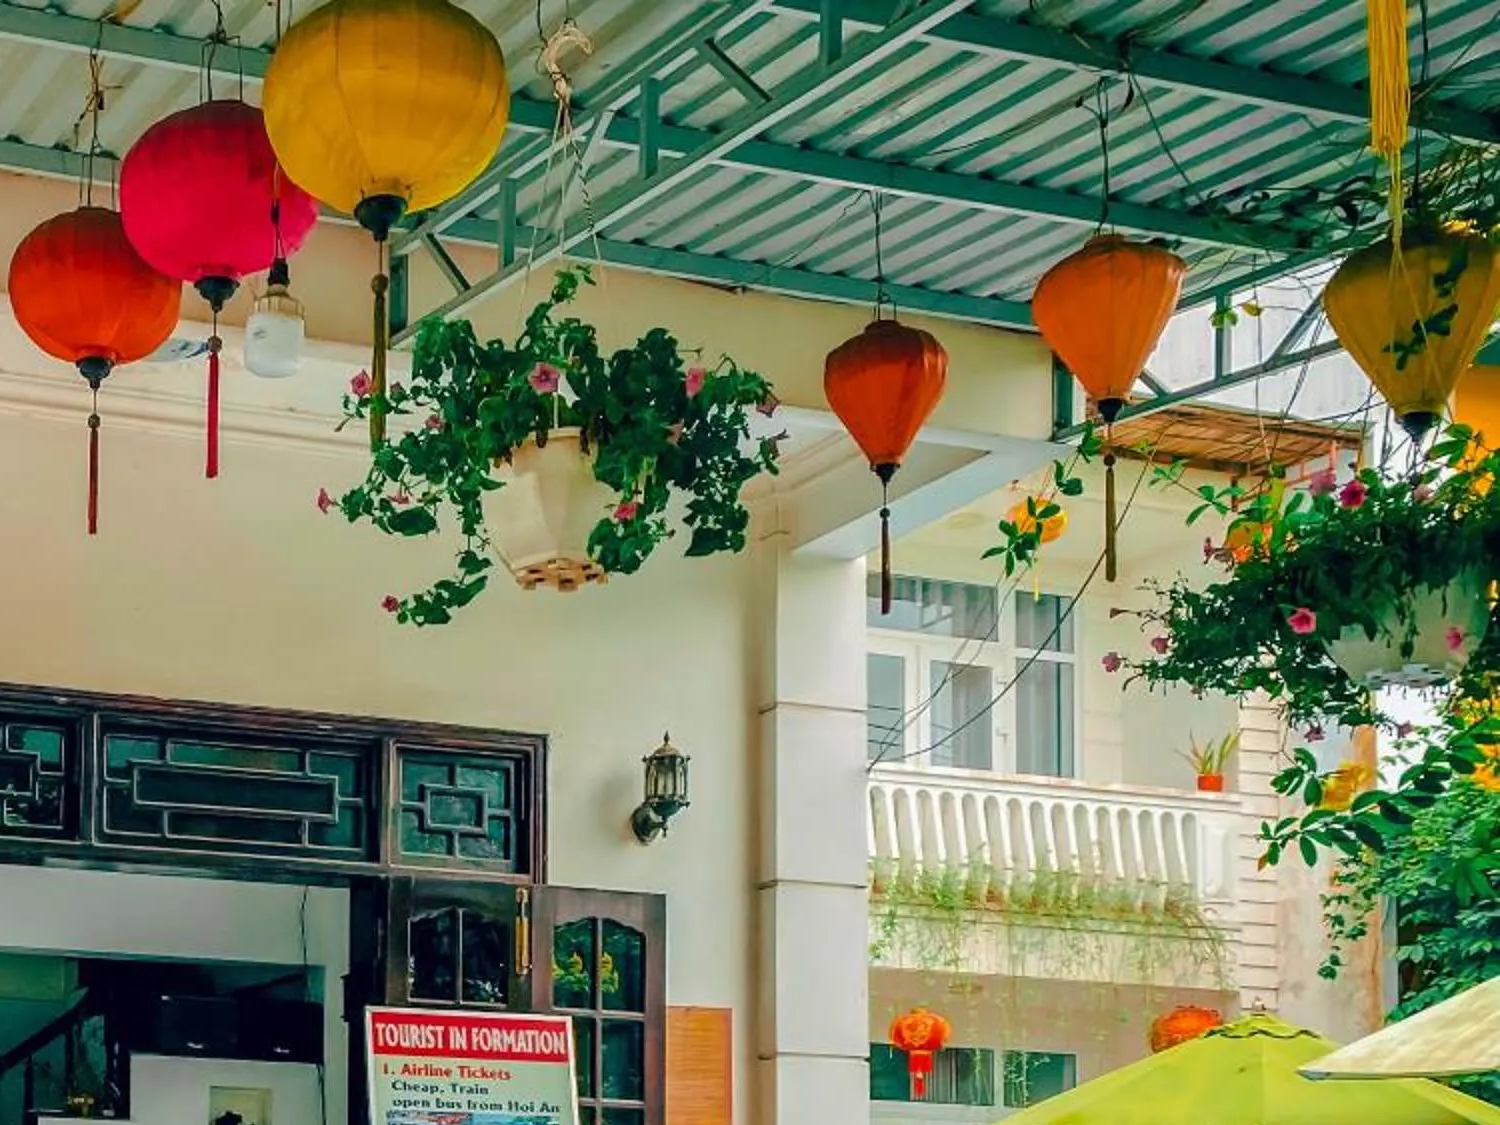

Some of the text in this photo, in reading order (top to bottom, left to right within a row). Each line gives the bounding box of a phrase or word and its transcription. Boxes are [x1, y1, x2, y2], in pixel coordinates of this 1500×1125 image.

[375, 1022, 565, 1054] TOURIST IN FORMATION
[383, 1063, 512, 1080] 1. Airline Tickets
[451, 1083, 489, 1094] Train
[393, 1098, 560, 1112] open bus from Hoi An
